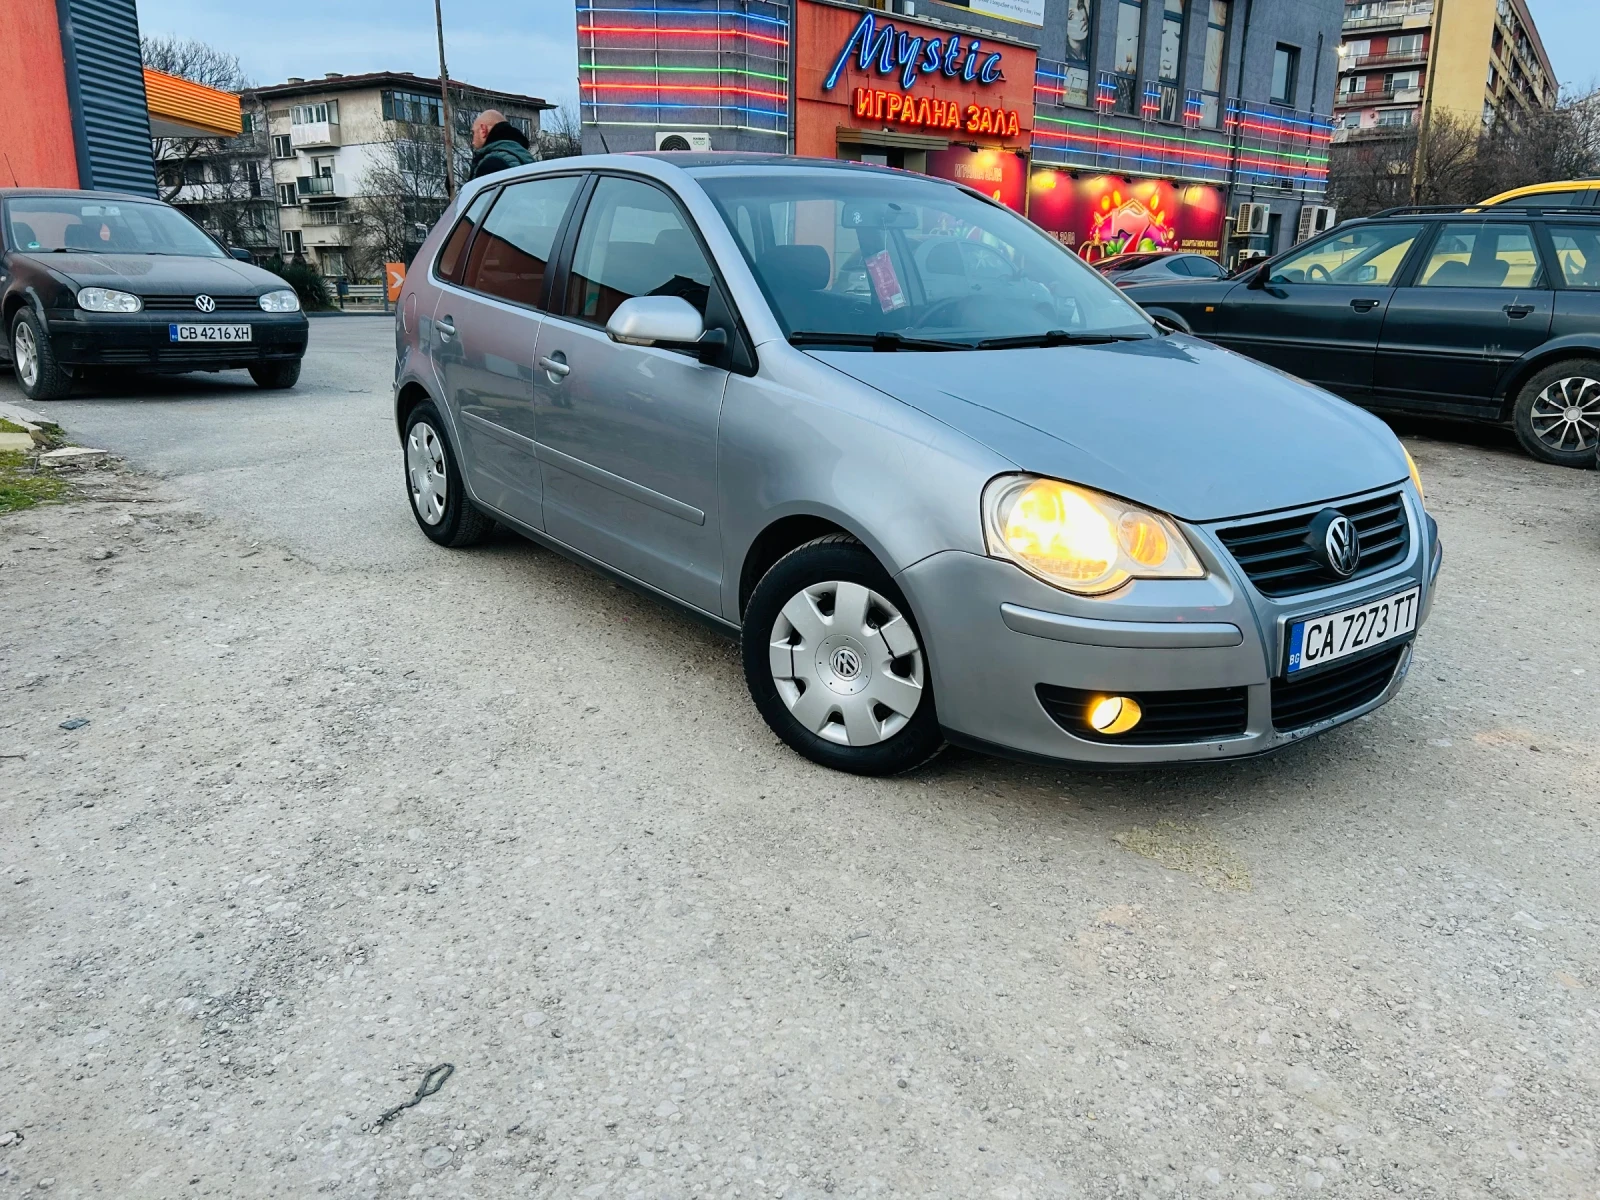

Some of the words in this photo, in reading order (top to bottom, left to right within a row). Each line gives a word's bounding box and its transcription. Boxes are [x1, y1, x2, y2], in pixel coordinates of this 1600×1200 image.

[824, 11, 1002, 90] Mystic
[855, 88, 961, 129] ИГРАЛНА
[967, 105, 1020, 137] ЗАЛА
[180, 327, 197, 340] CB
[201, 327, 231, 340] 4216
[233, 327, 249, 340] XH
[1305, 620, 1333, 661] CA
[1339, 604, 1389, 652] 7273
[1393, 593, 1416, 632] TT
[1289, 653, 1300, 665] BG
